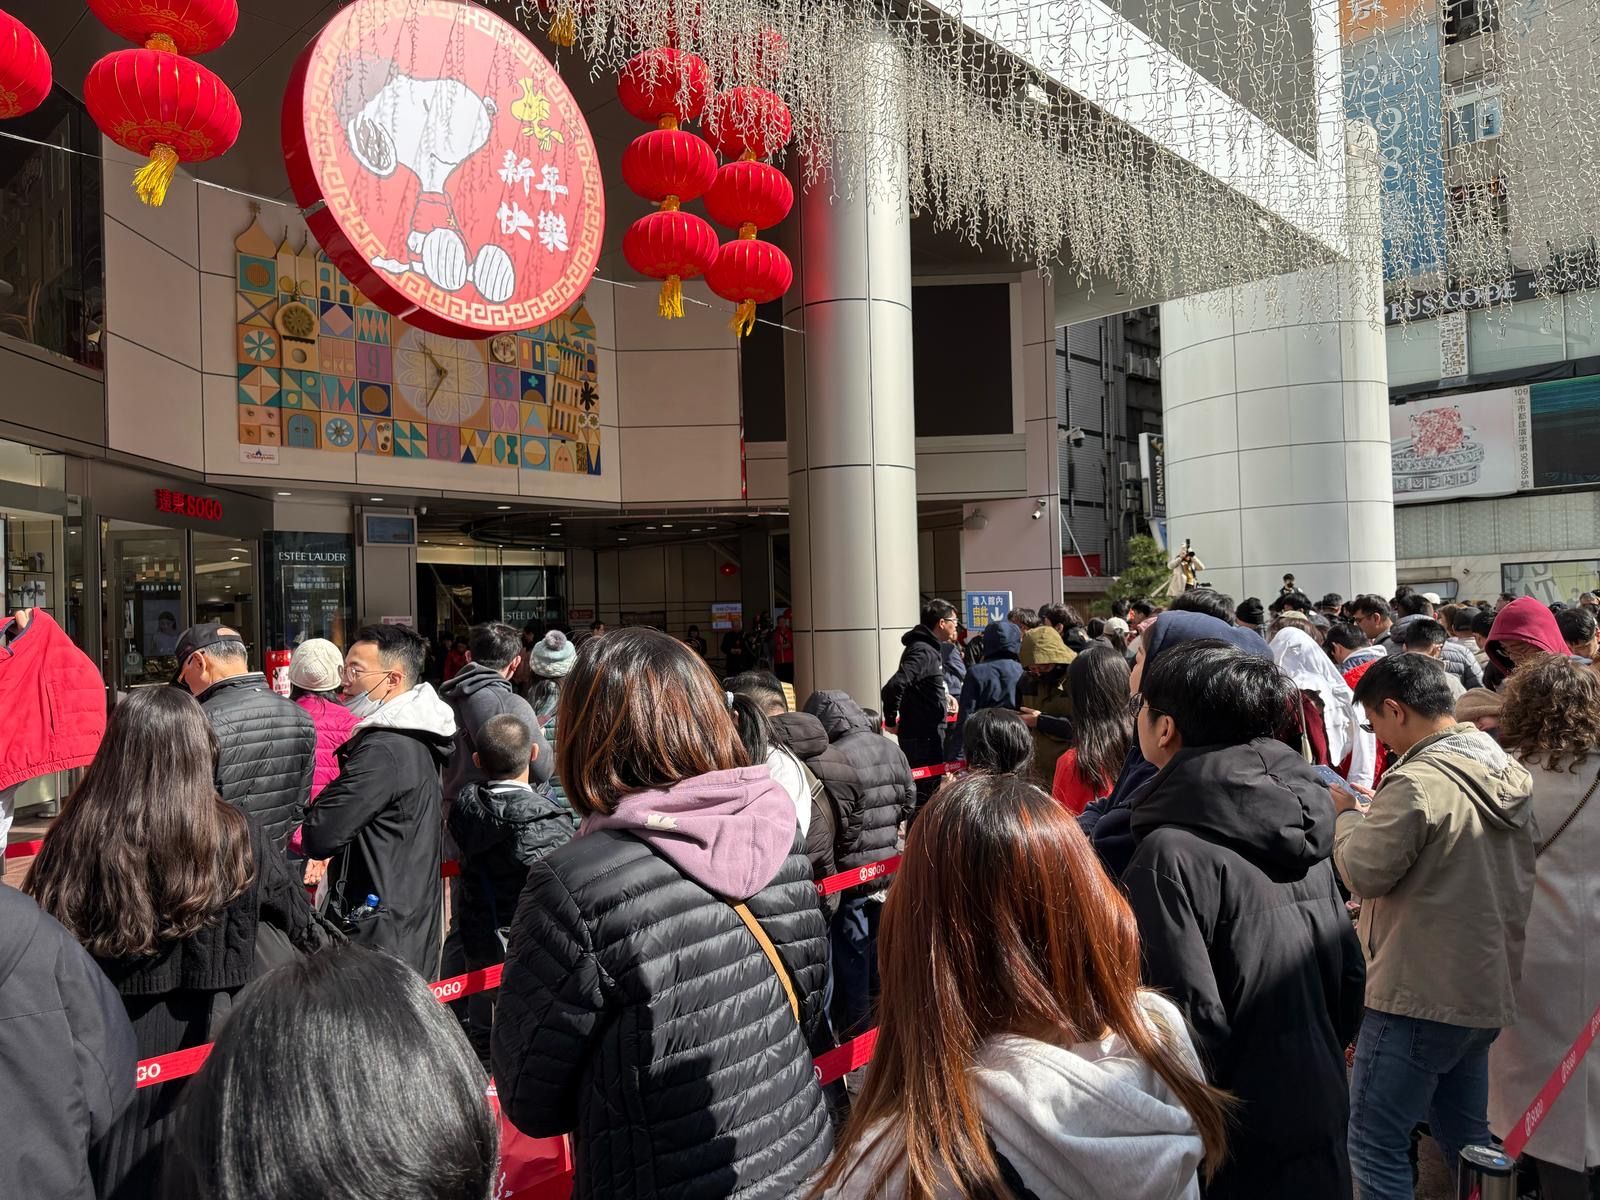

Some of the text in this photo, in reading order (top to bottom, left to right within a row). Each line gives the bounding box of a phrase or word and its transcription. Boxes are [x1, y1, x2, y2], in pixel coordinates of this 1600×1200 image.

[497, 149, 569, 206] 新年
[496, 201, 570, 254] 快樂
[1383, 280, 1518, 321] LUS CODE
[187, 495, 223, 520] SOGO
[308, 552, 347, 562] LAUDER
[867, 863, 886, 878] SOGO
[432, 981, 461, 999] OGO
[136, 1063, 161, 1082] GO
